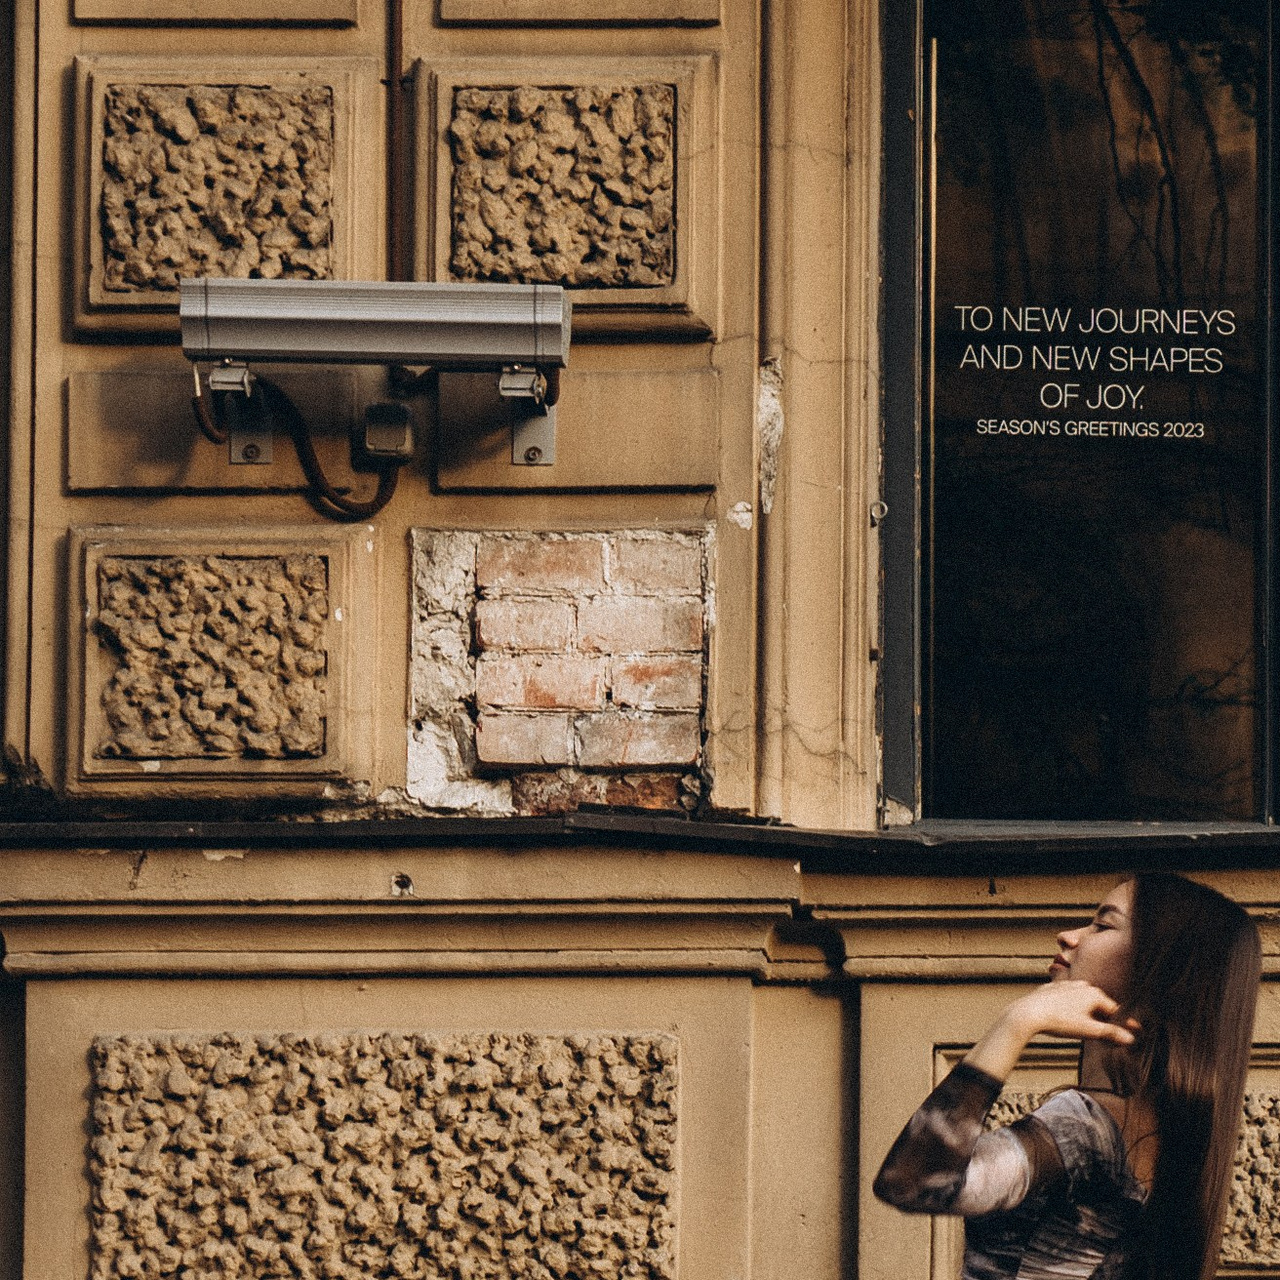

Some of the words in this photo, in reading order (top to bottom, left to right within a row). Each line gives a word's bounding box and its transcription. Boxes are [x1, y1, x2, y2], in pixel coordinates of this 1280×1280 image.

[954, 305, 993, 332] TO
[1002, 306, 1072, 333] NEW
[1078, 307, 1236, 336] JOURNEYS
[959, 344, 1023, 370] AND
[1032, 345, 1101, 371] NEW
[1109, 346, 1223, 374] SHAPES
[1039, 382, 1080, 409] OF
[1086, 383, 1145, 410] JOY.
[976, 419, 1061, 436] SEASON'S
[1064, 421, 1160, 438] GREETINGS
[1163, 422, 1205, 439] 2023
